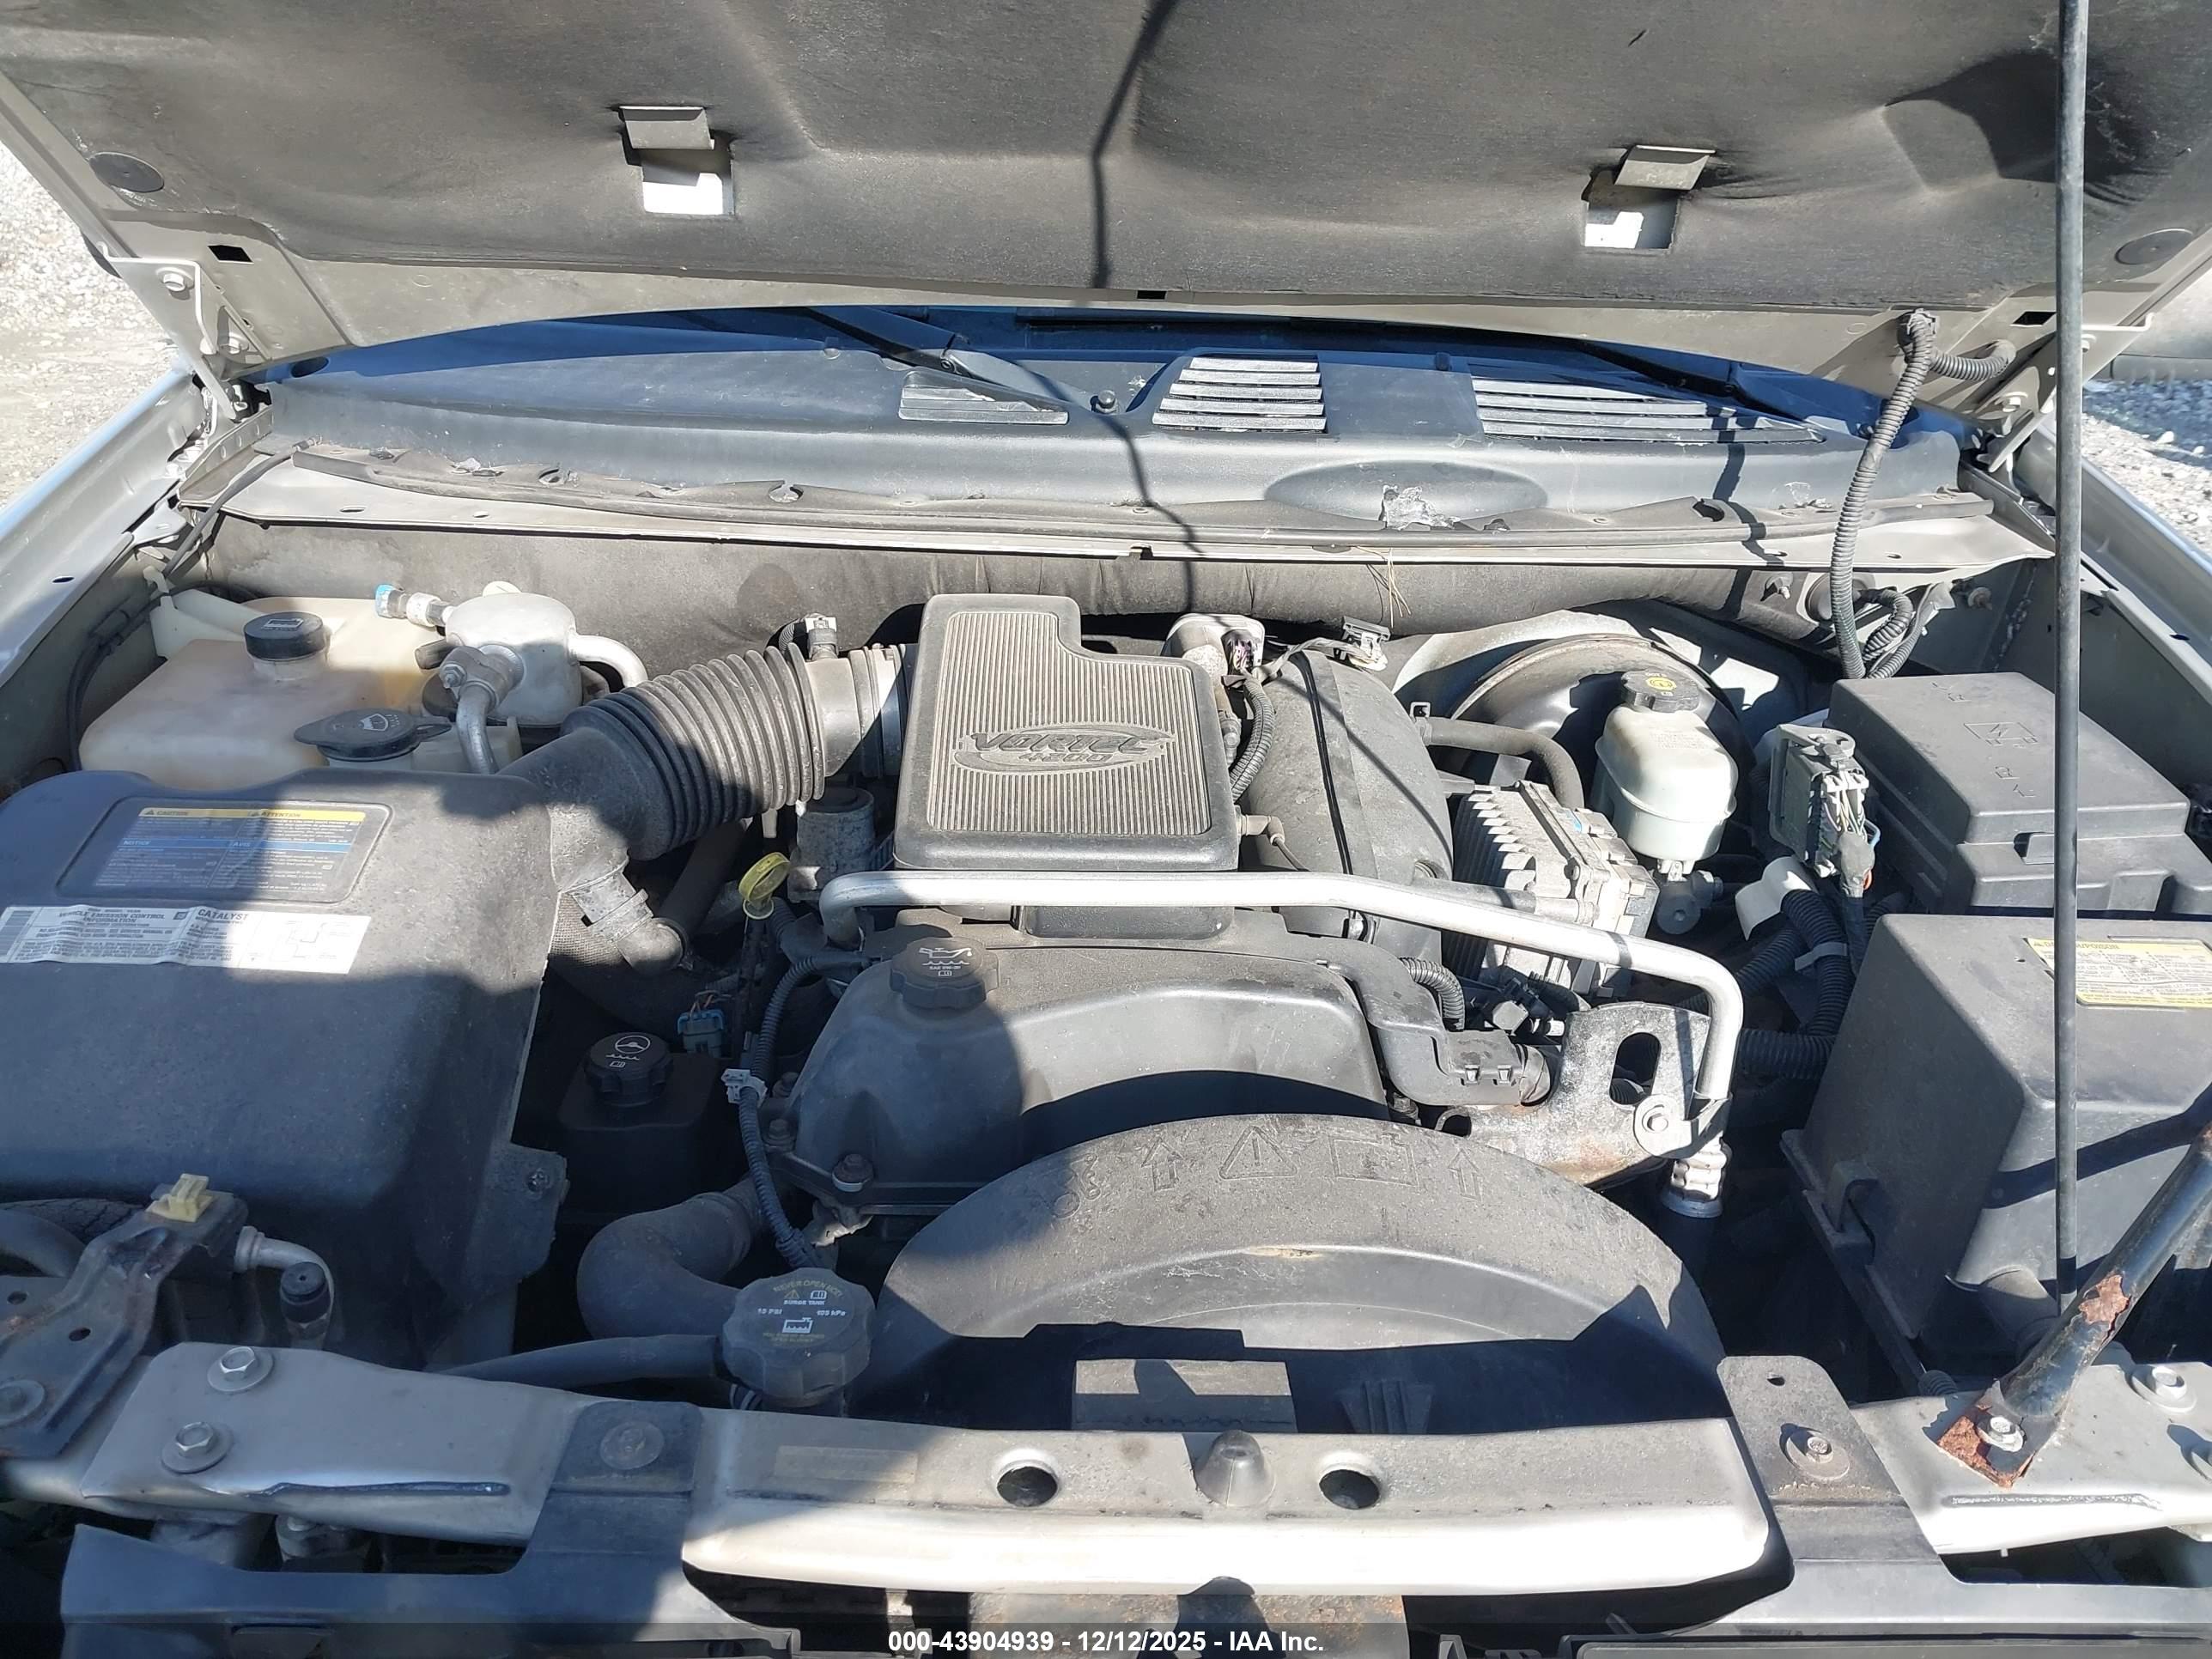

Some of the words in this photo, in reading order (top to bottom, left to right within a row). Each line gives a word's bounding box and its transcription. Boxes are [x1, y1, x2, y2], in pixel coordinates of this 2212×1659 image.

[970, 732, 1151, 755] VORTEC
[1018, 752, 1114, 763] 4200
[198, 908, 249, 921] CATALYST
[803, 1279, 826, 1289] OPEN
